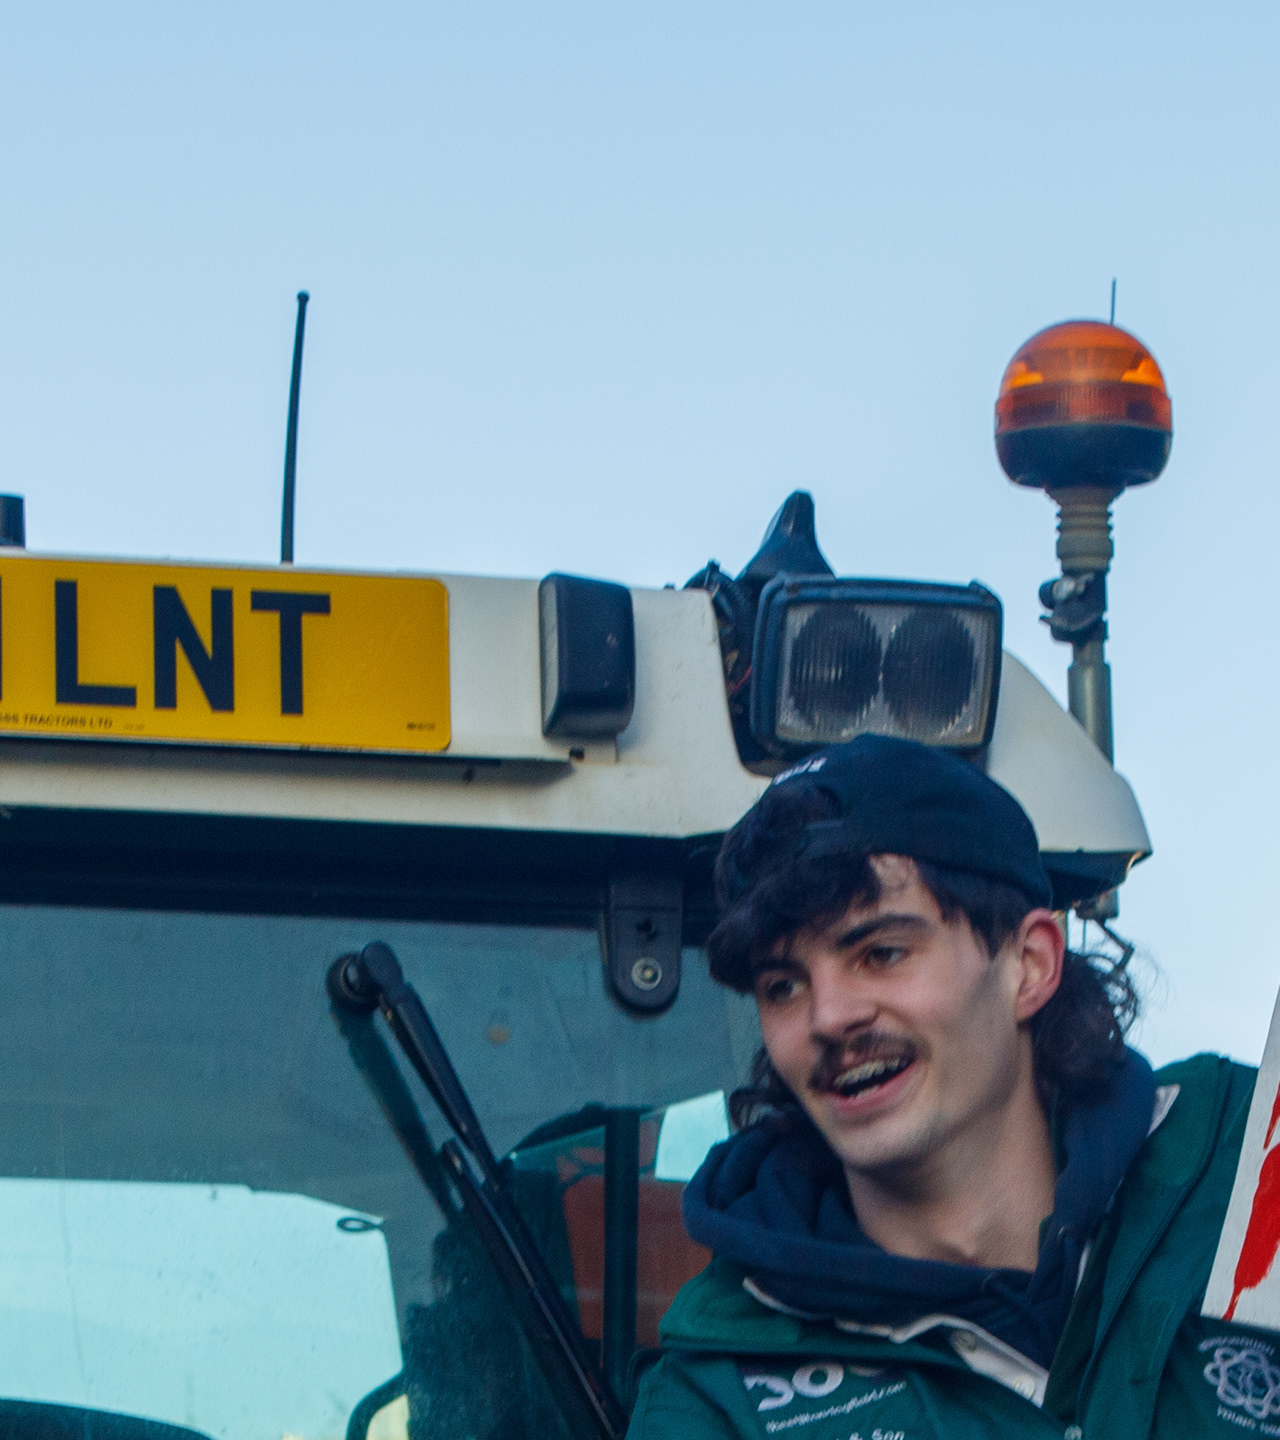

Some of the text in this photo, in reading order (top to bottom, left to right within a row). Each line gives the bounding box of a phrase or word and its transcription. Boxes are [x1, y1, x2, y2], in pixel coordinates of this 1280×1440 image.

[54, 579, 332, 717] LNT
[23, 714, 86, 728] TRACTORS
[89, 718, 113, 730] LTD
